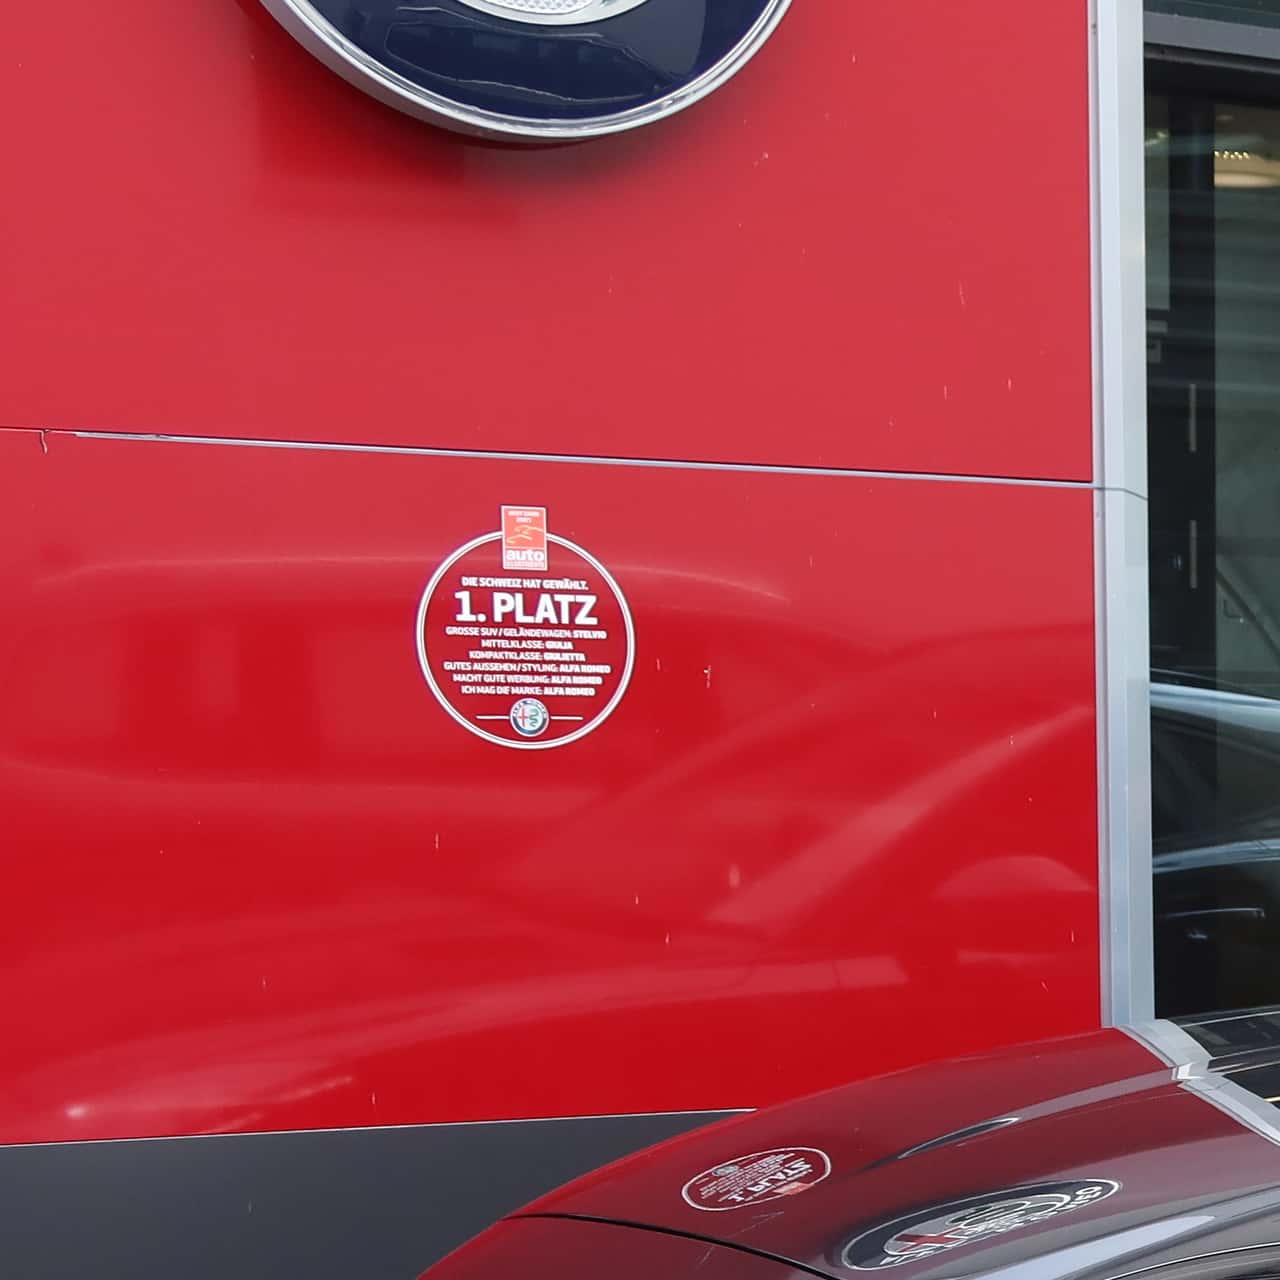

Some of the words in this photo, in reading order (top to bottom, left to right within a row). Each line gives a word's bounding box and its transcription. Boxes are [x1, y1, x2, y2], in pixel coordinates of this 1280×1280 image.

[506, 549, 545, 562] auto
[461, 576, 479, 587] DIE
[479, 577, 522, 589] SCHWEIZ
[523, 578, 541, 589] HAT
[454, 590, 487, 623] 1.
[493, 591, 598, 625] PLATZ
[445, 626, 479, 636] GROSSE
[480, 627, 498, 637] SUV
[443, 661, 472, 671] GUTES
[453, 673, 482, 683] MACHT
